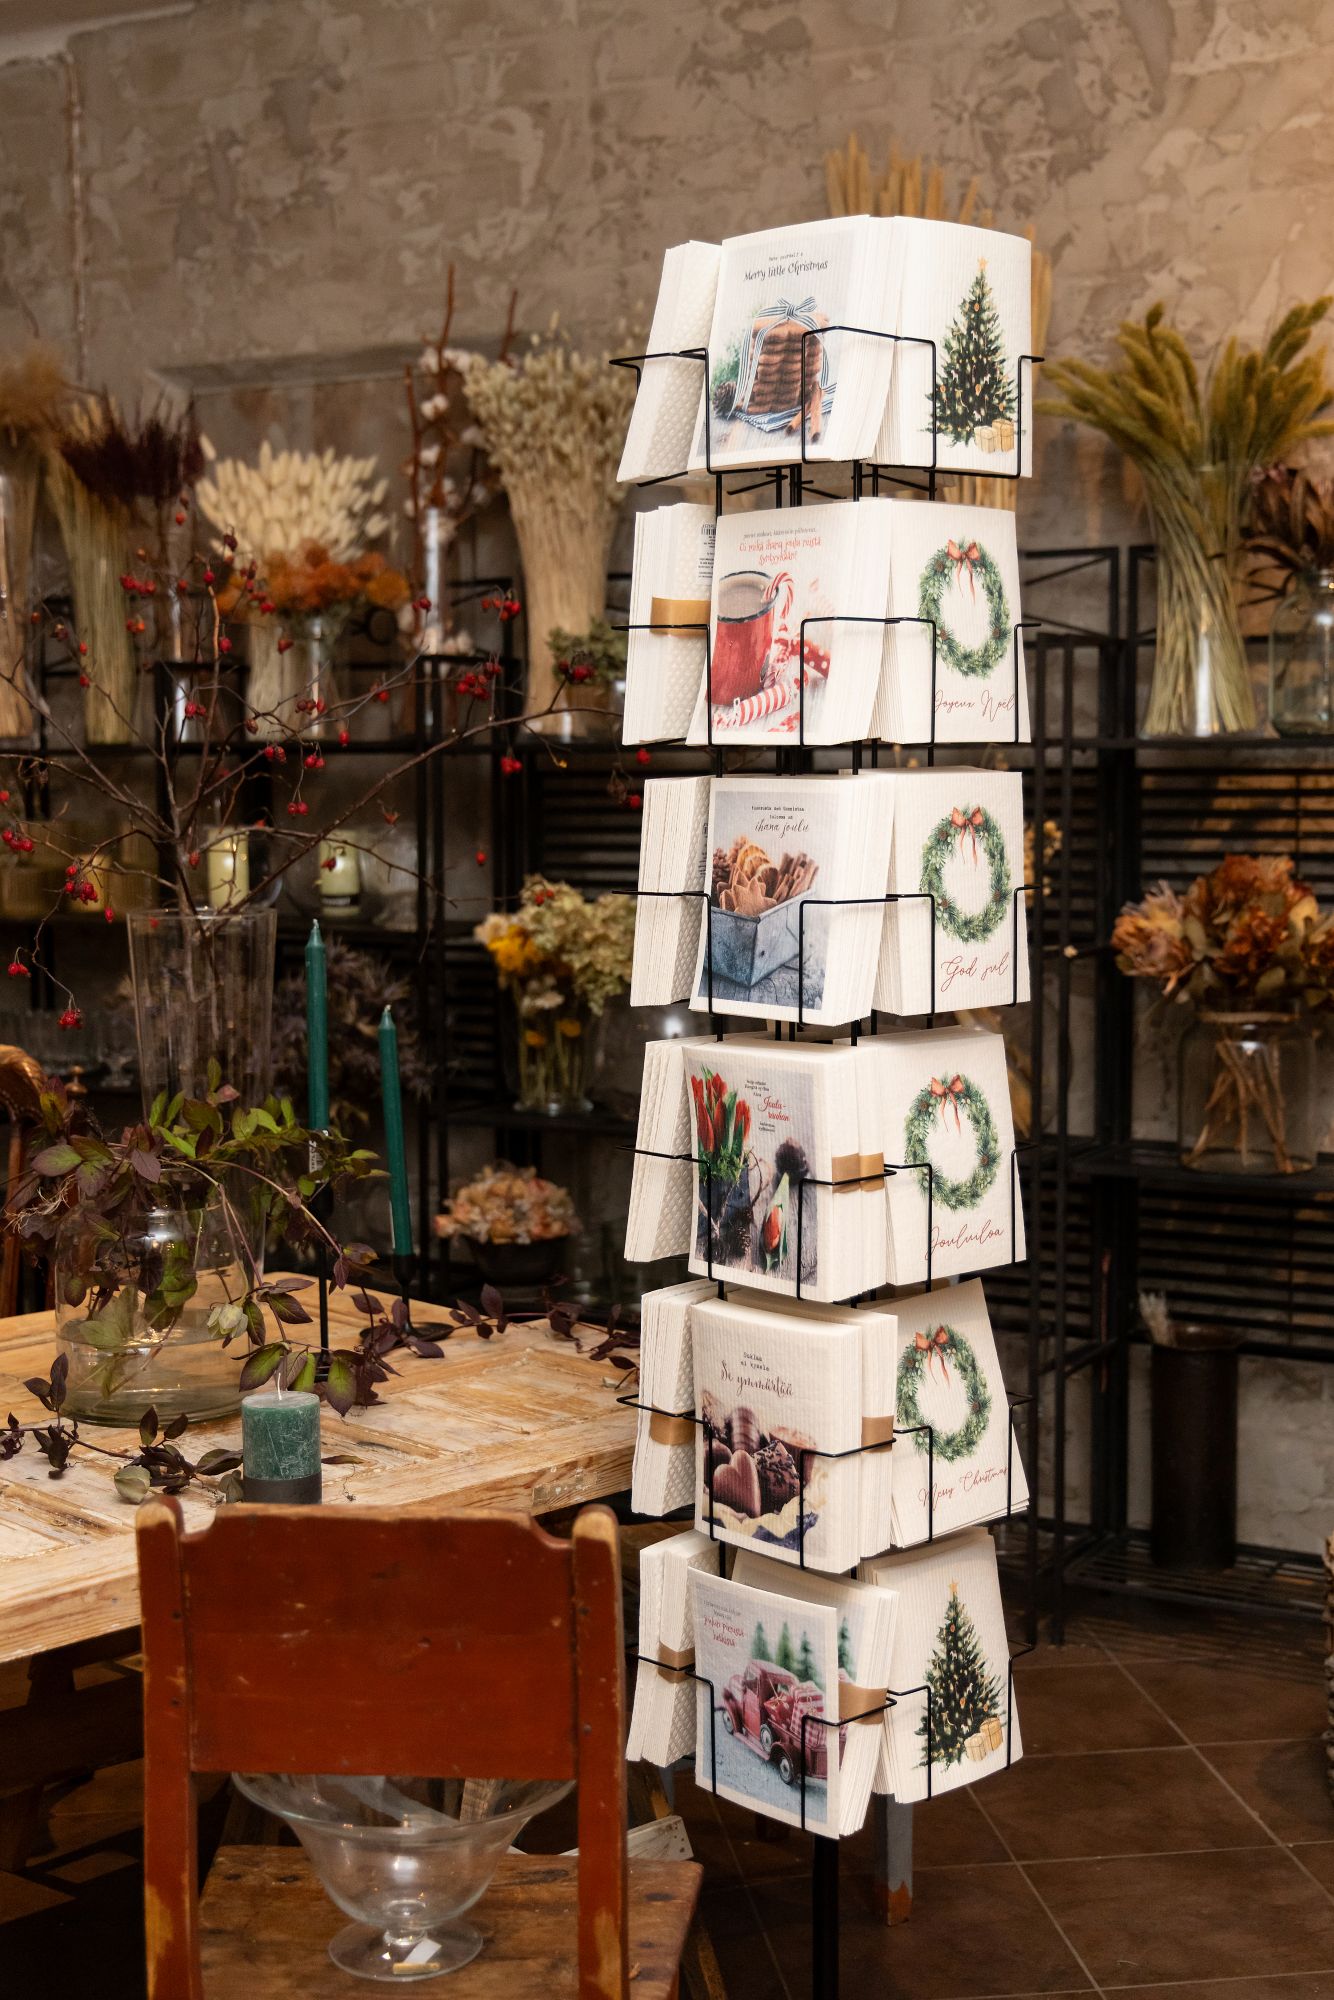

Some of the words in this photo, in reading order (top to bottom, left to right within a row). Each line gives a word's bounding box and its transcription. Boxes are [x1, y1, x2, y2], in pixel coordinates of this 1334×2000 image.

[743, 268, 766, 281] Merry
[768, 264, 786, 277] little
[788, 260, 829, 276] Christmas
[754, 818, 780, 832] ihana
[778, 819, 809, 840] joulu
[940, 955, 978, 993] God
[980, 951, 1010, 981] jul
[924, 1219, 1005, 1261] Jouluiloa
[736, 1376, 793, 1398] ymmärtää
